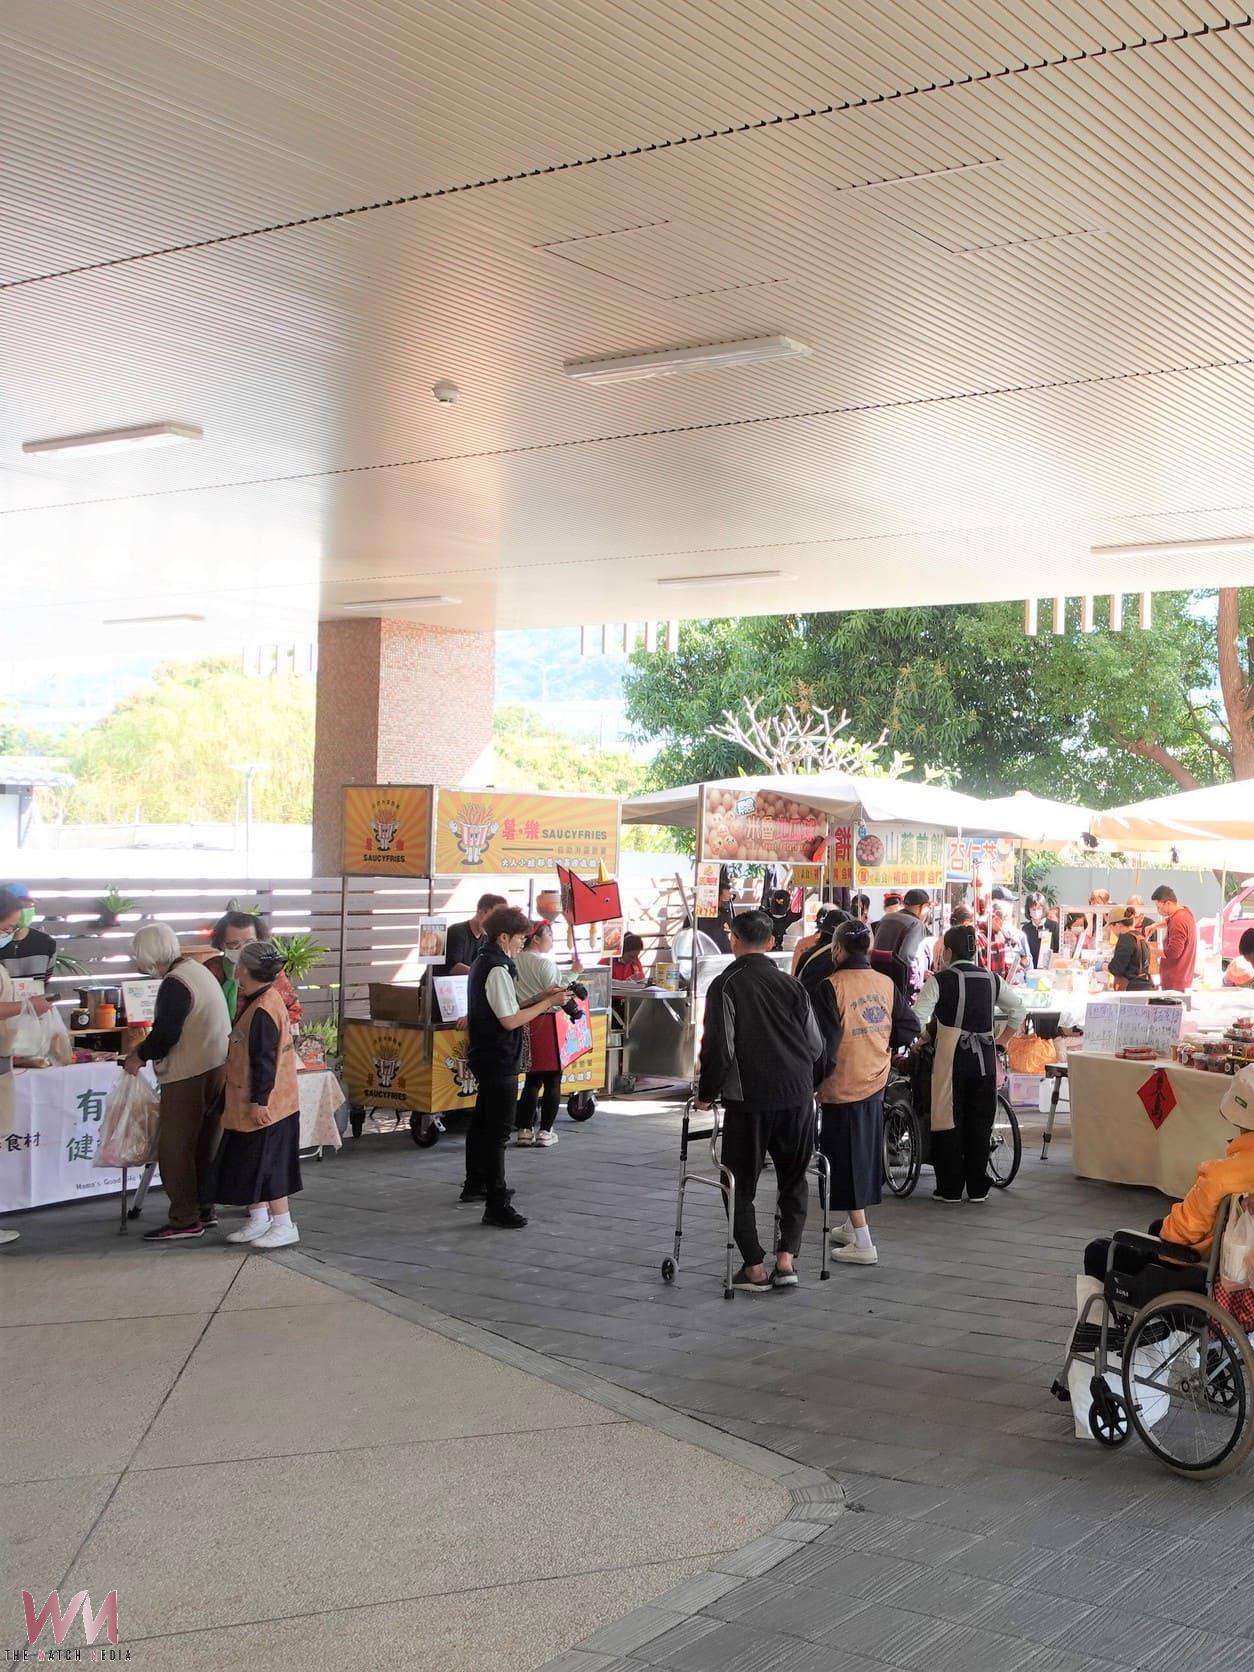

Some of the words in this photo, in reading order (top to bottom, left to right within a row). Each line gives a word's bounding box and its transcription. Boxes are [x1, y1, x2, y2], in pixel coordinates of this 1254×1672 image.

[542, 829, 607, 840] SAUCYFRIES
[363, 854, 406, 863] SAUCYFRIES
[364, 1089, 408, 1101] SAUCYFRIES
[77, 1088, 108, 1123] 有
[4, 1132, 41, 1151] 食材
[66, 1133, 102, 1163] 健
